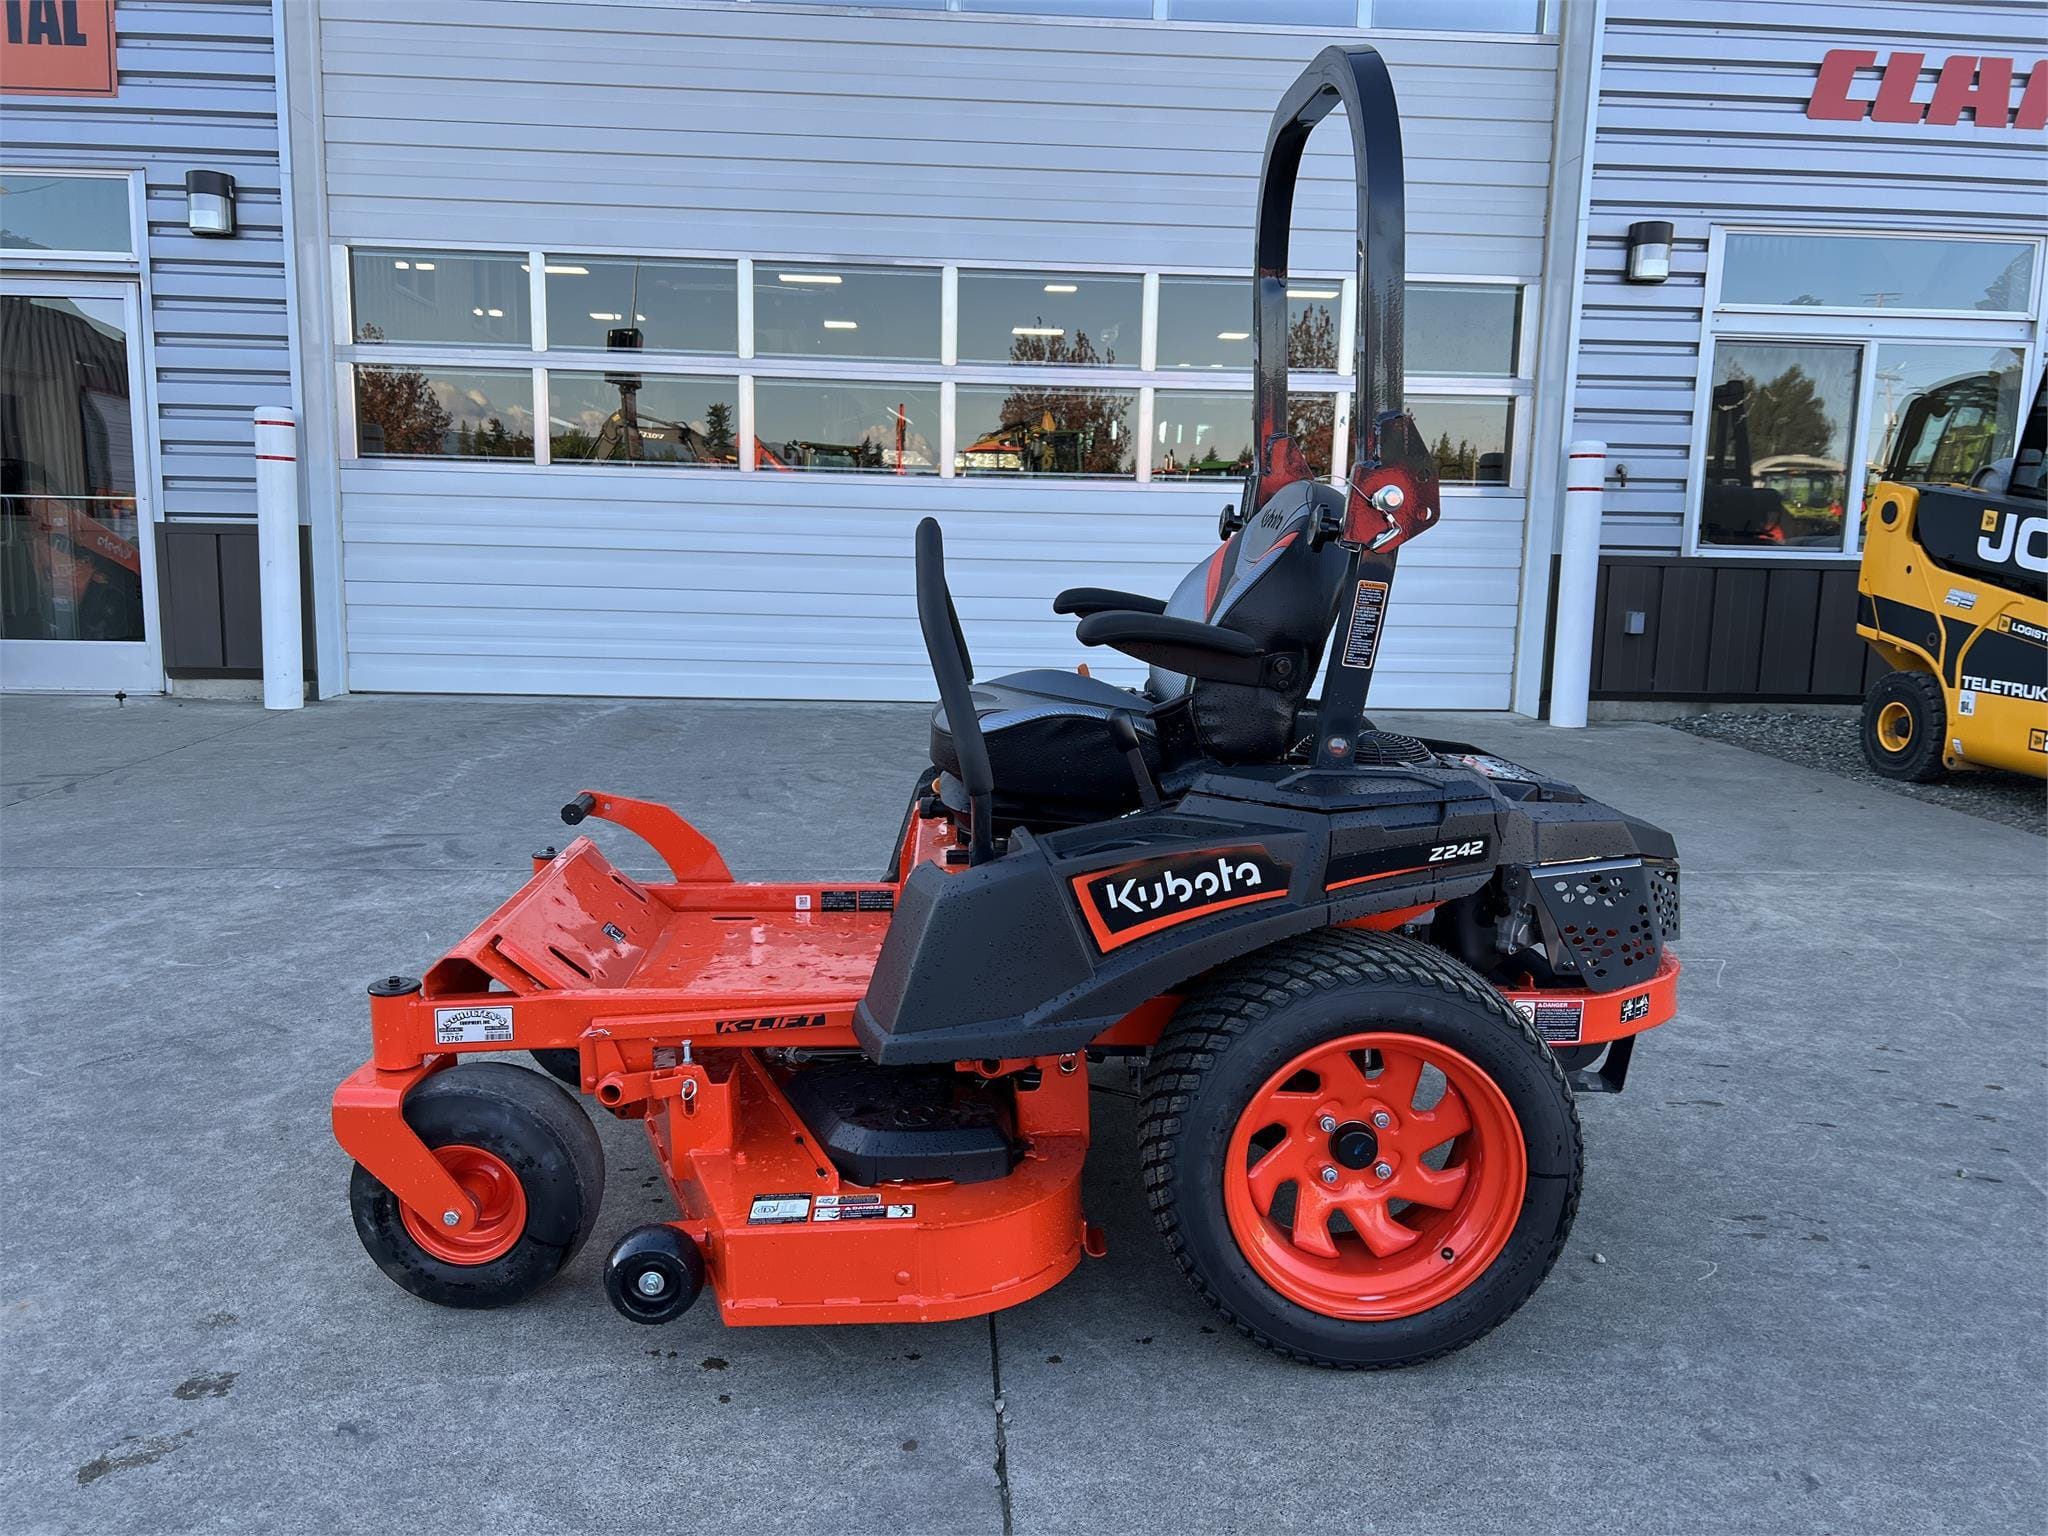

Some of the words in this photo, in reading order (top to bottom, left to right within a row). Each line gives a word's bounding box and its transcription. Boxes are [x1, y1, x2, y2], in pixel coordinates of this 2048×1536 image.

[1428, 840, 1484, 862] Z242
[1106, 857, 1262, 913] Kubota
[720, 1014, 823, 1033] K-LIFT
